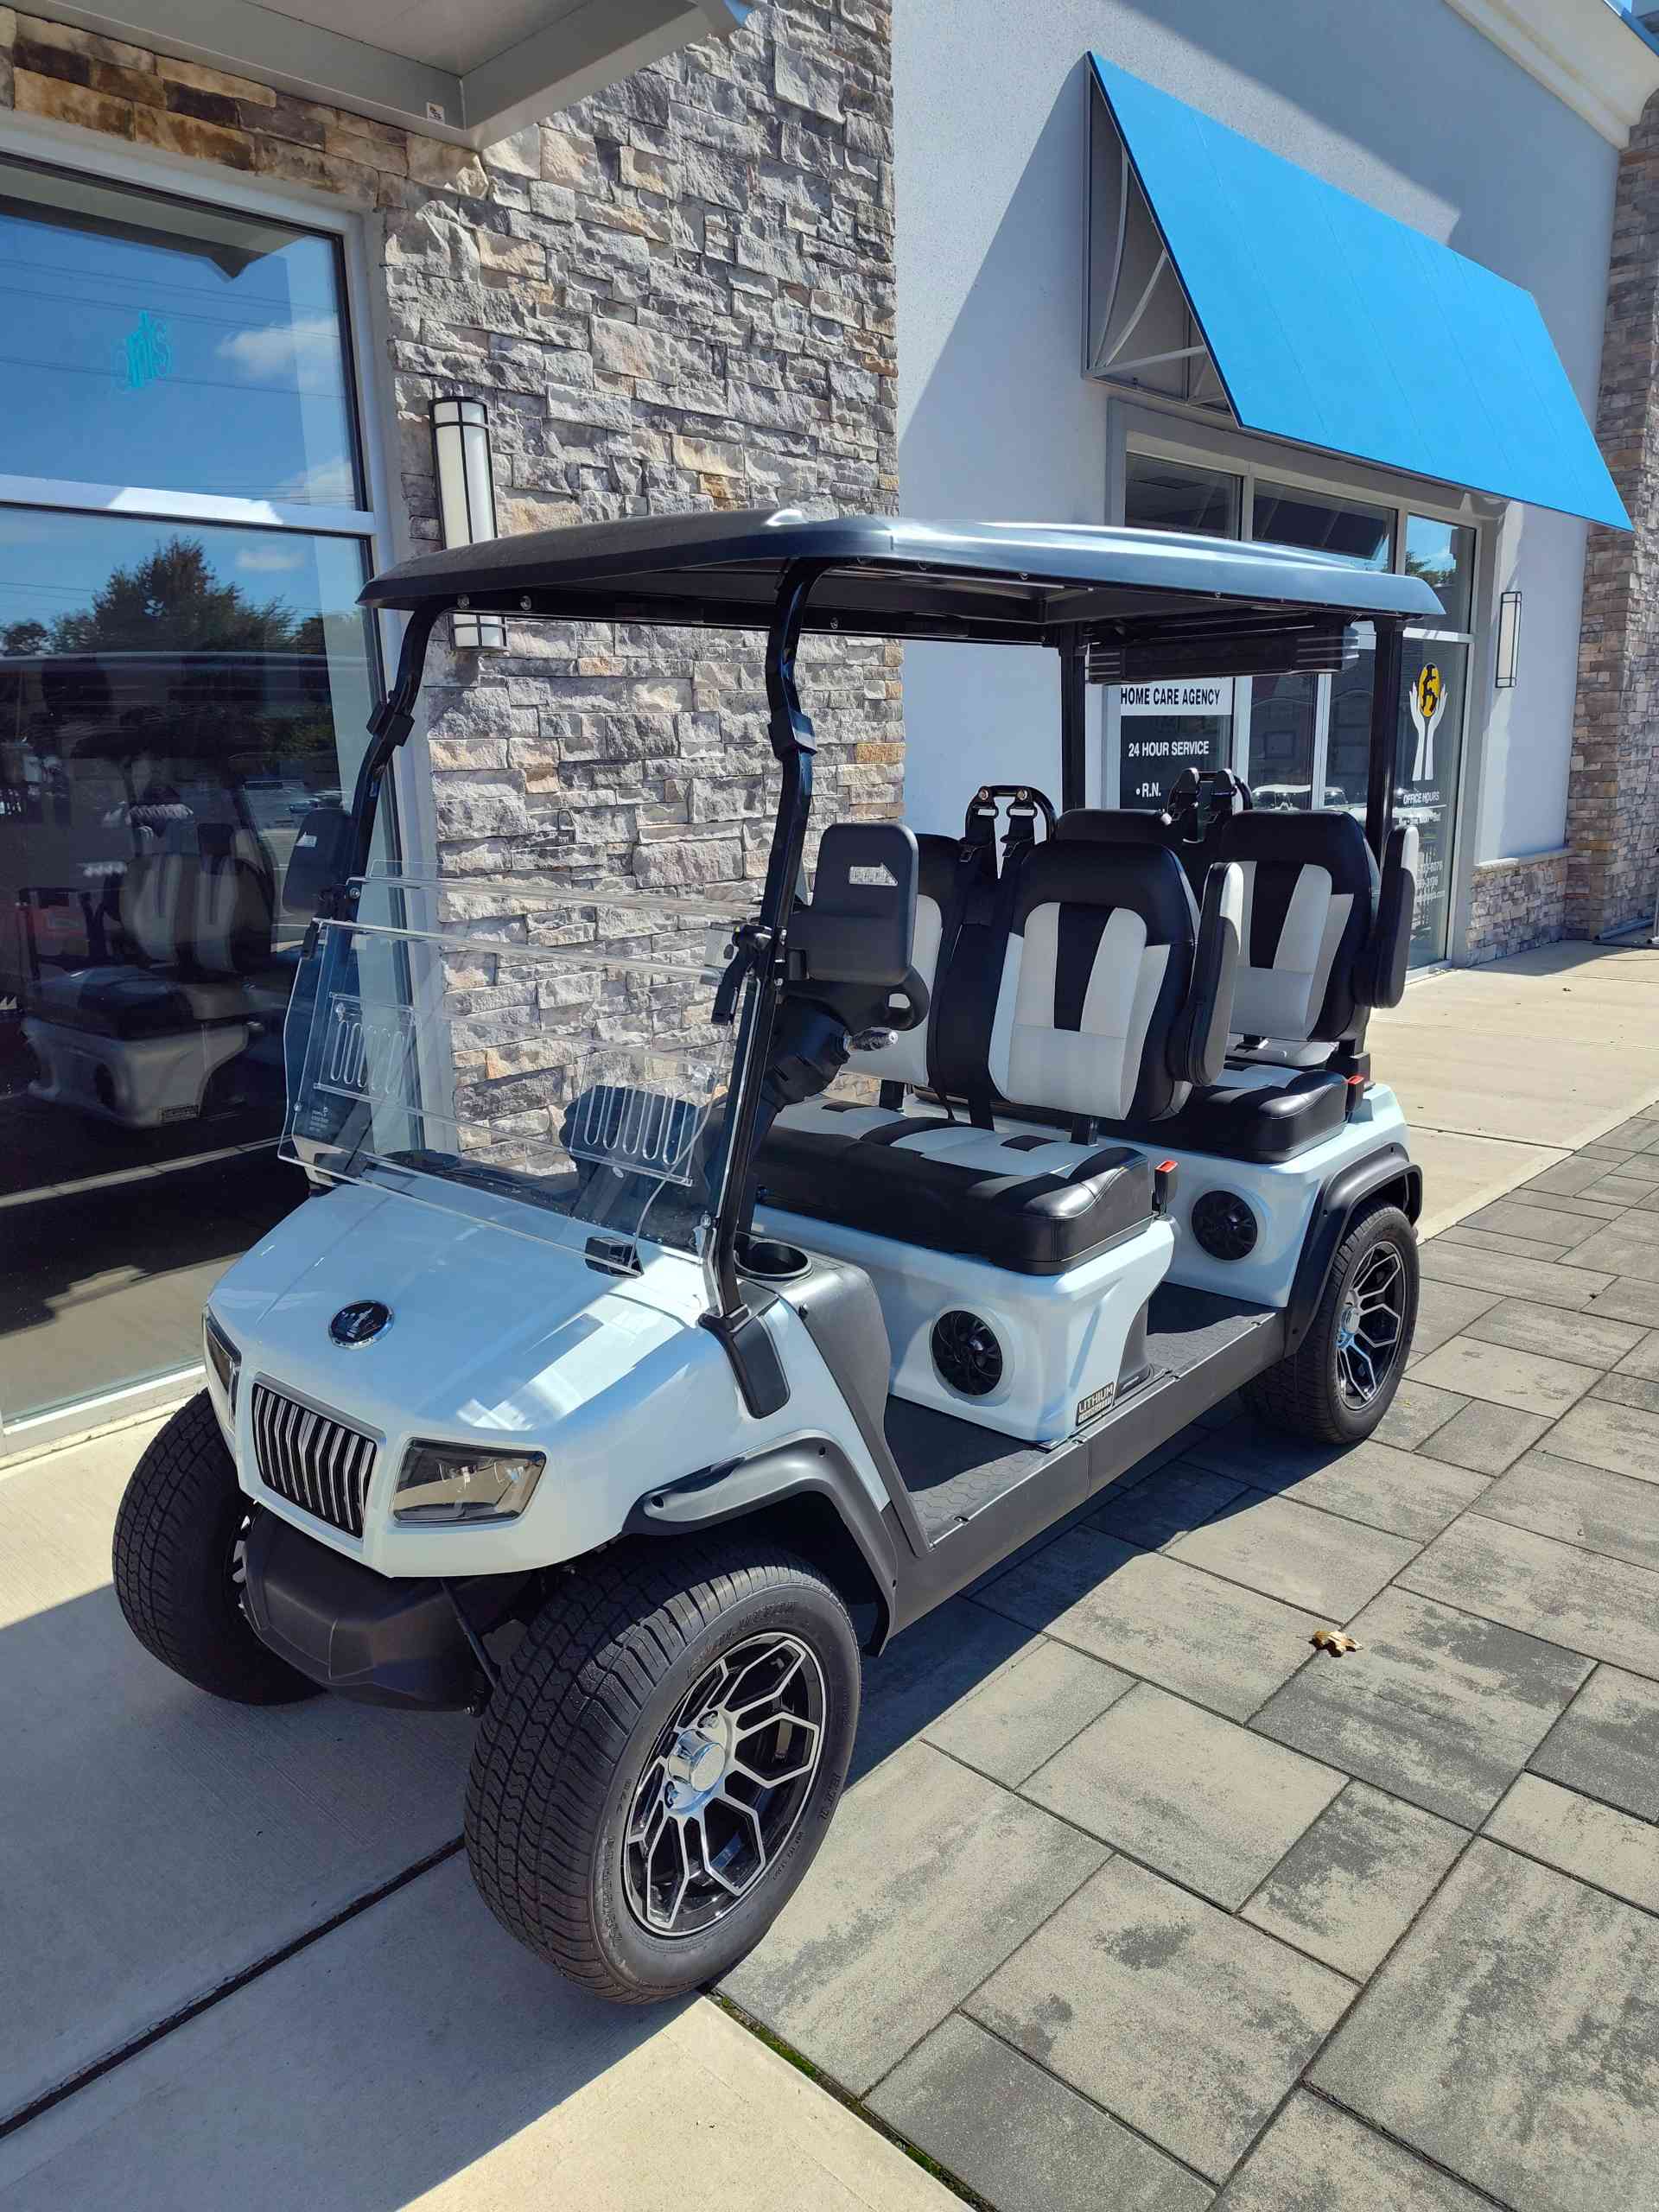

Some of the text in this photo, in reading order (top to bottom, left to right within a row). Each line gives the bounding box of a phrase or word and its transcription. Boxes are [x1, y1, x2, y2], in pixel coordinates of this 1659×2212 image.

[1121, 687, 1220, 705] HOME CARE AGENCY
[1128, 741, 1210, 757] 24 HOUR SERVICE
[1141, 782, 1161, 798] R.N.
[1403, 791, 1440, 804] OFFICE HOURS
[1079, 1383, 1114, 1413] LITHIUM
